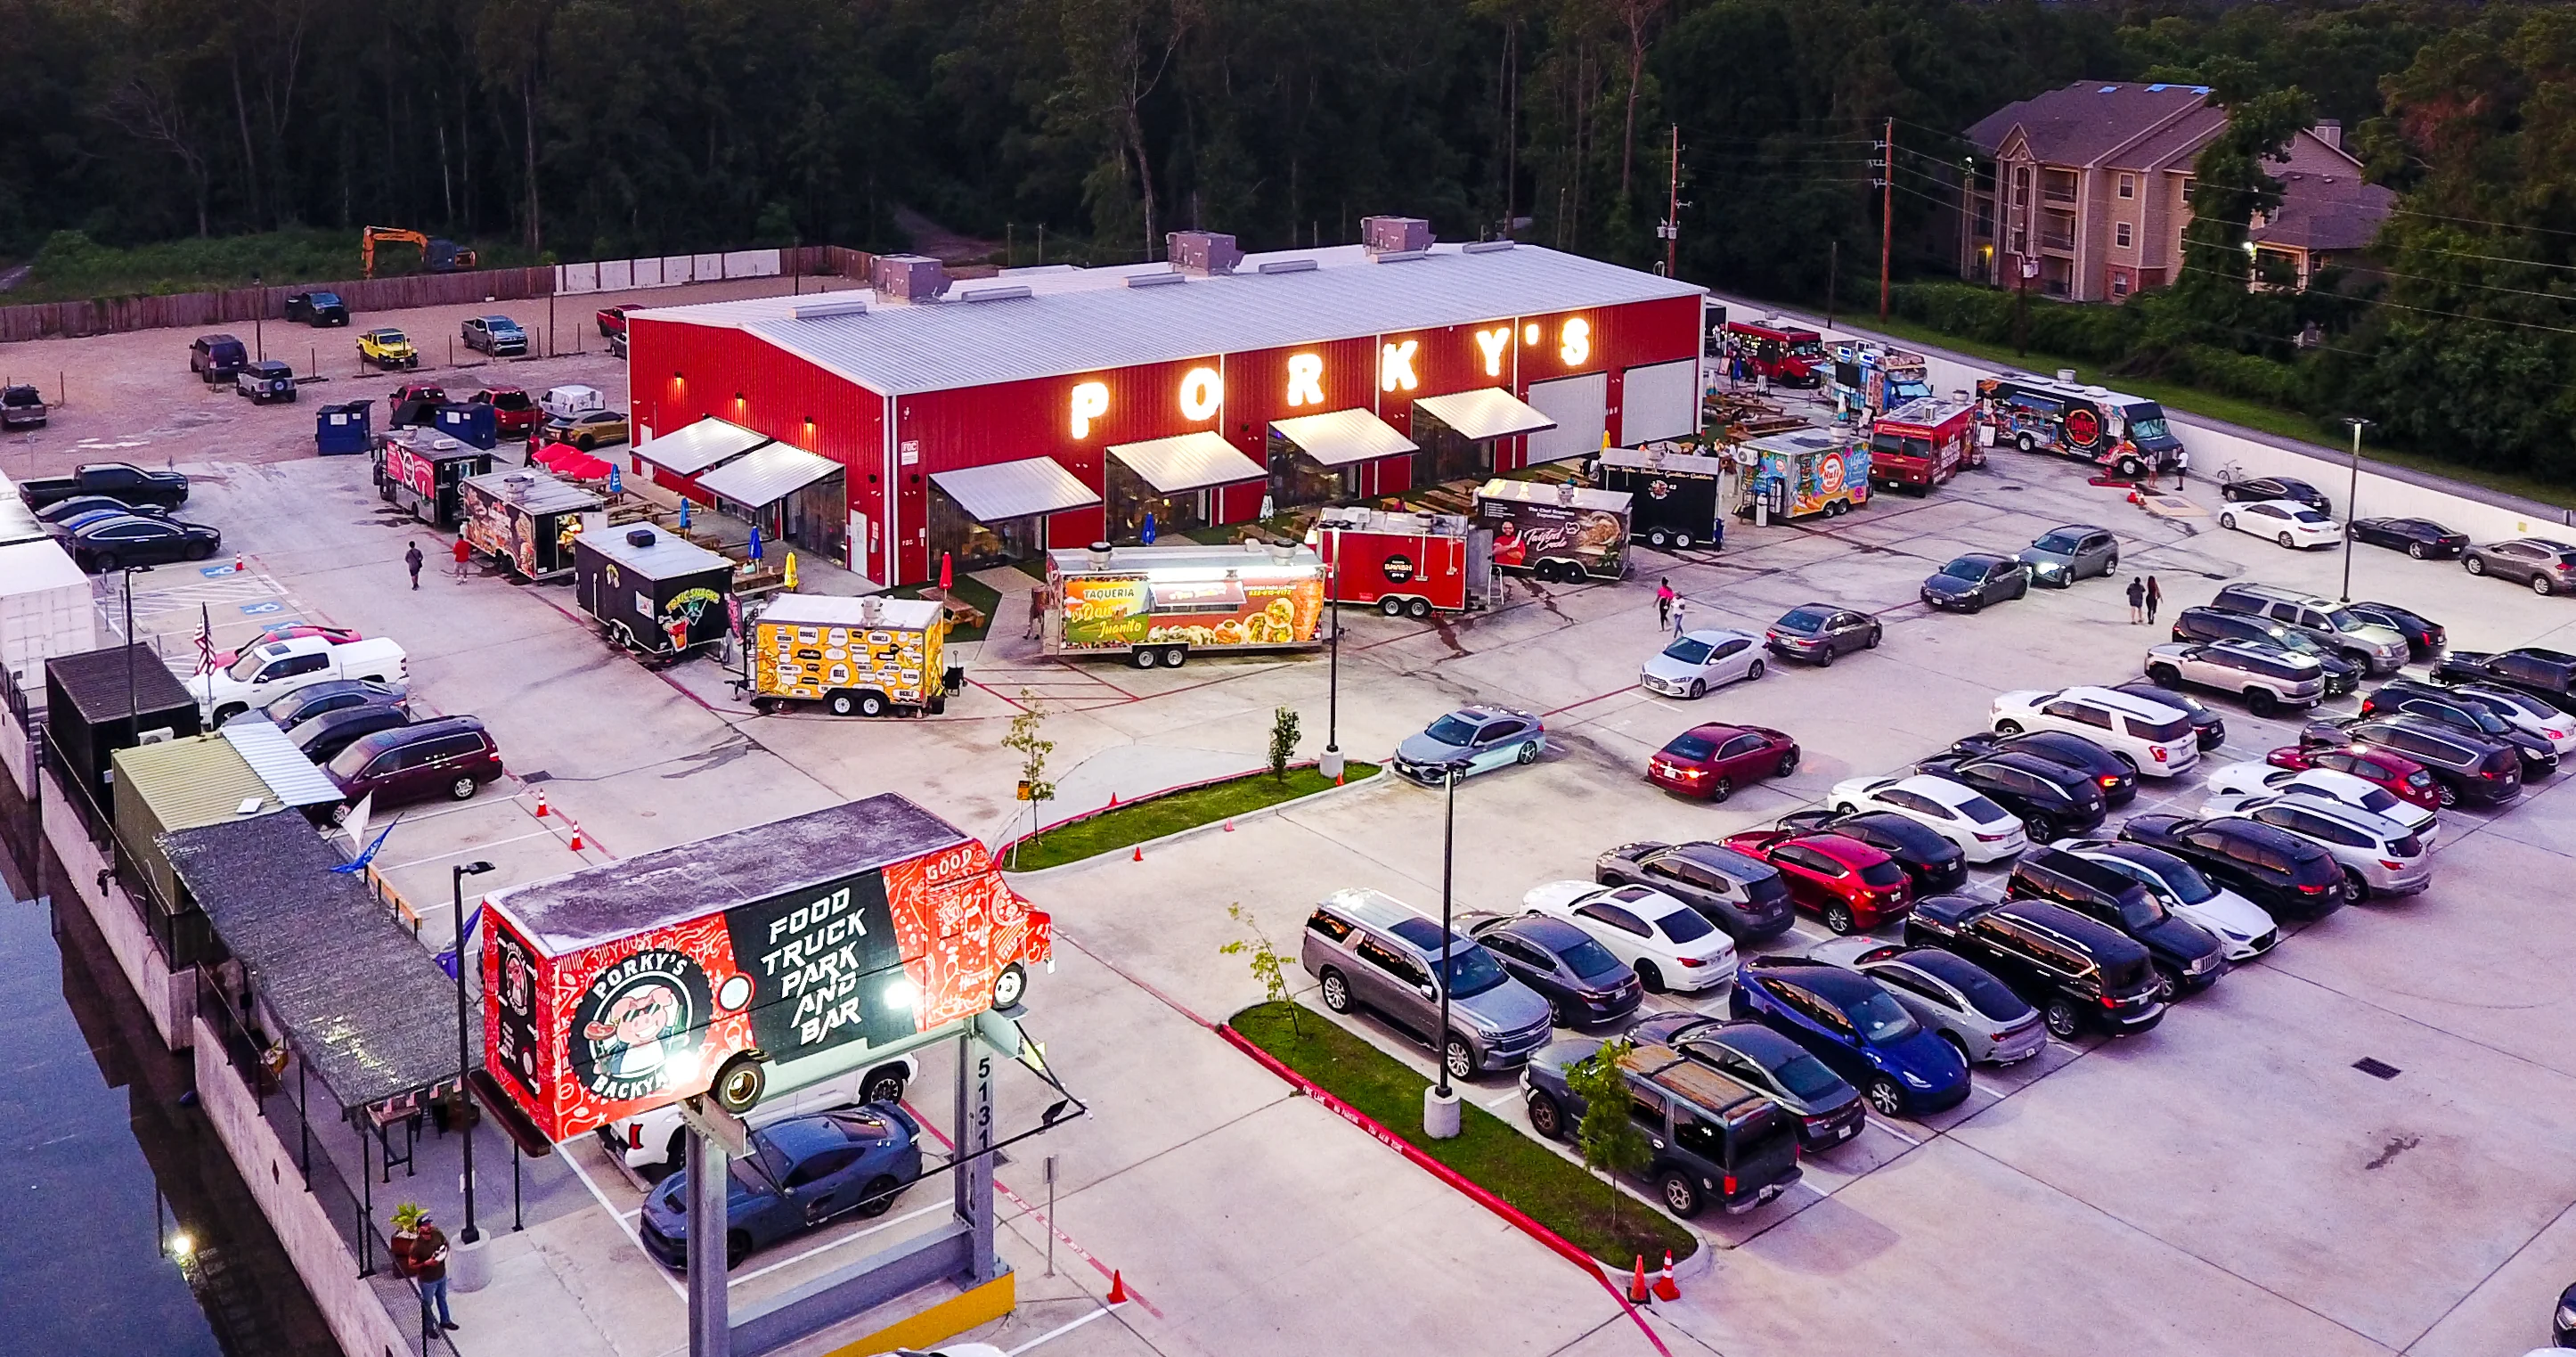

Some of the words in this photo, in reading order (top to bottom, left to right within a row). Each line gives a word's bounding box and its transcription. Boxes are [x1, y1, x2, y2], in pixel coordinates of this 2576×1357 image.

[1071, 316, 1593, 440] PORKY'S
[1083, 587, 1136, 601] TAQUERIA
[1097, 618, 1143, 639] Juanito
[925, 848, 974, 881] GOOD
[760, 907, 868, 977] TRUCK
[769, 887, 851, 946] FOOD
[591, 952, 689, 1001] PORKY'S
[780, 940, 860, 999] PARK
[790, 970, 858, 1029] AND
[799, 996, 863, 1046] BAR
[977, 1057, 990, 1150] 5131
